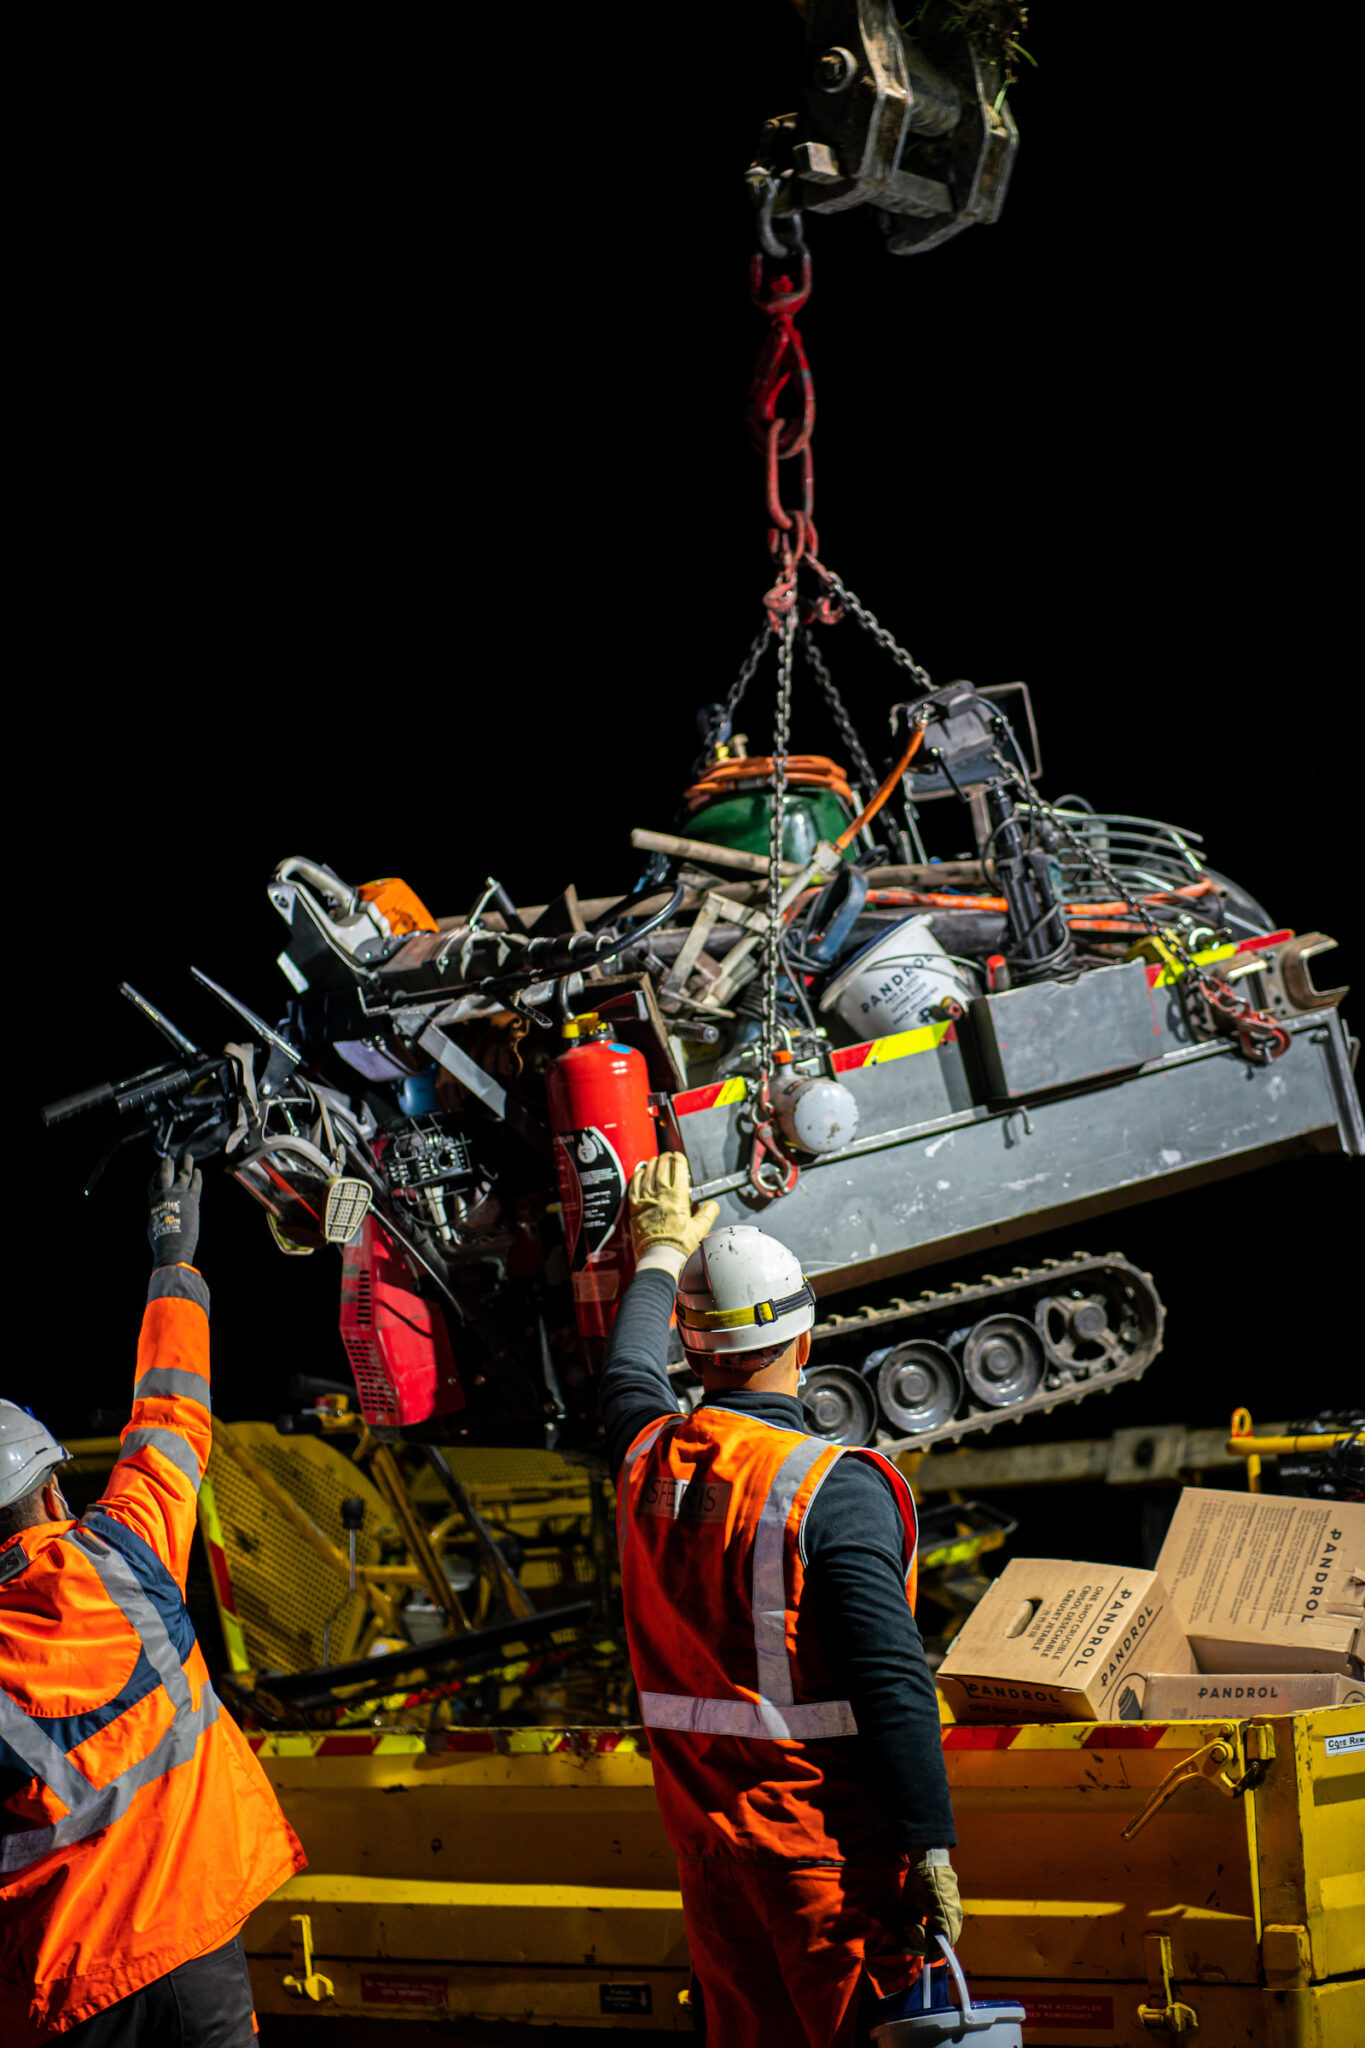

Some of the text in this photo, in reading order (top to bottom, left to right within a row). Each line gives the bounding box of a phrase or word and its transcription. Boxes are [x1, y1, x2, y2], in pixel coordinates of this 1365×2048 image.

[646, 1479, 717, 1513] SFERIS
[1301, 1528, 1343, 1623] PANDROL
[1055, 1589, 1077, 1620] CREUSET
[1075, 1585, 1092, 1611] CRISOL
[1031, 1620, 1055, 1651] JETABLE
[1040, 1611, 1076, 1658] DESECHABLE
[1051, 1585, 1105, 1661] ONE SHOT CRUCIBLE
[1074, 1588, 1133, 1668] PANDROL
[1101, 1606, 1154, 1687] PANDROL
[967, 1682, 1061, 1703] PANDROL
[1197, 1686, 1279, 1699] PANDROL
